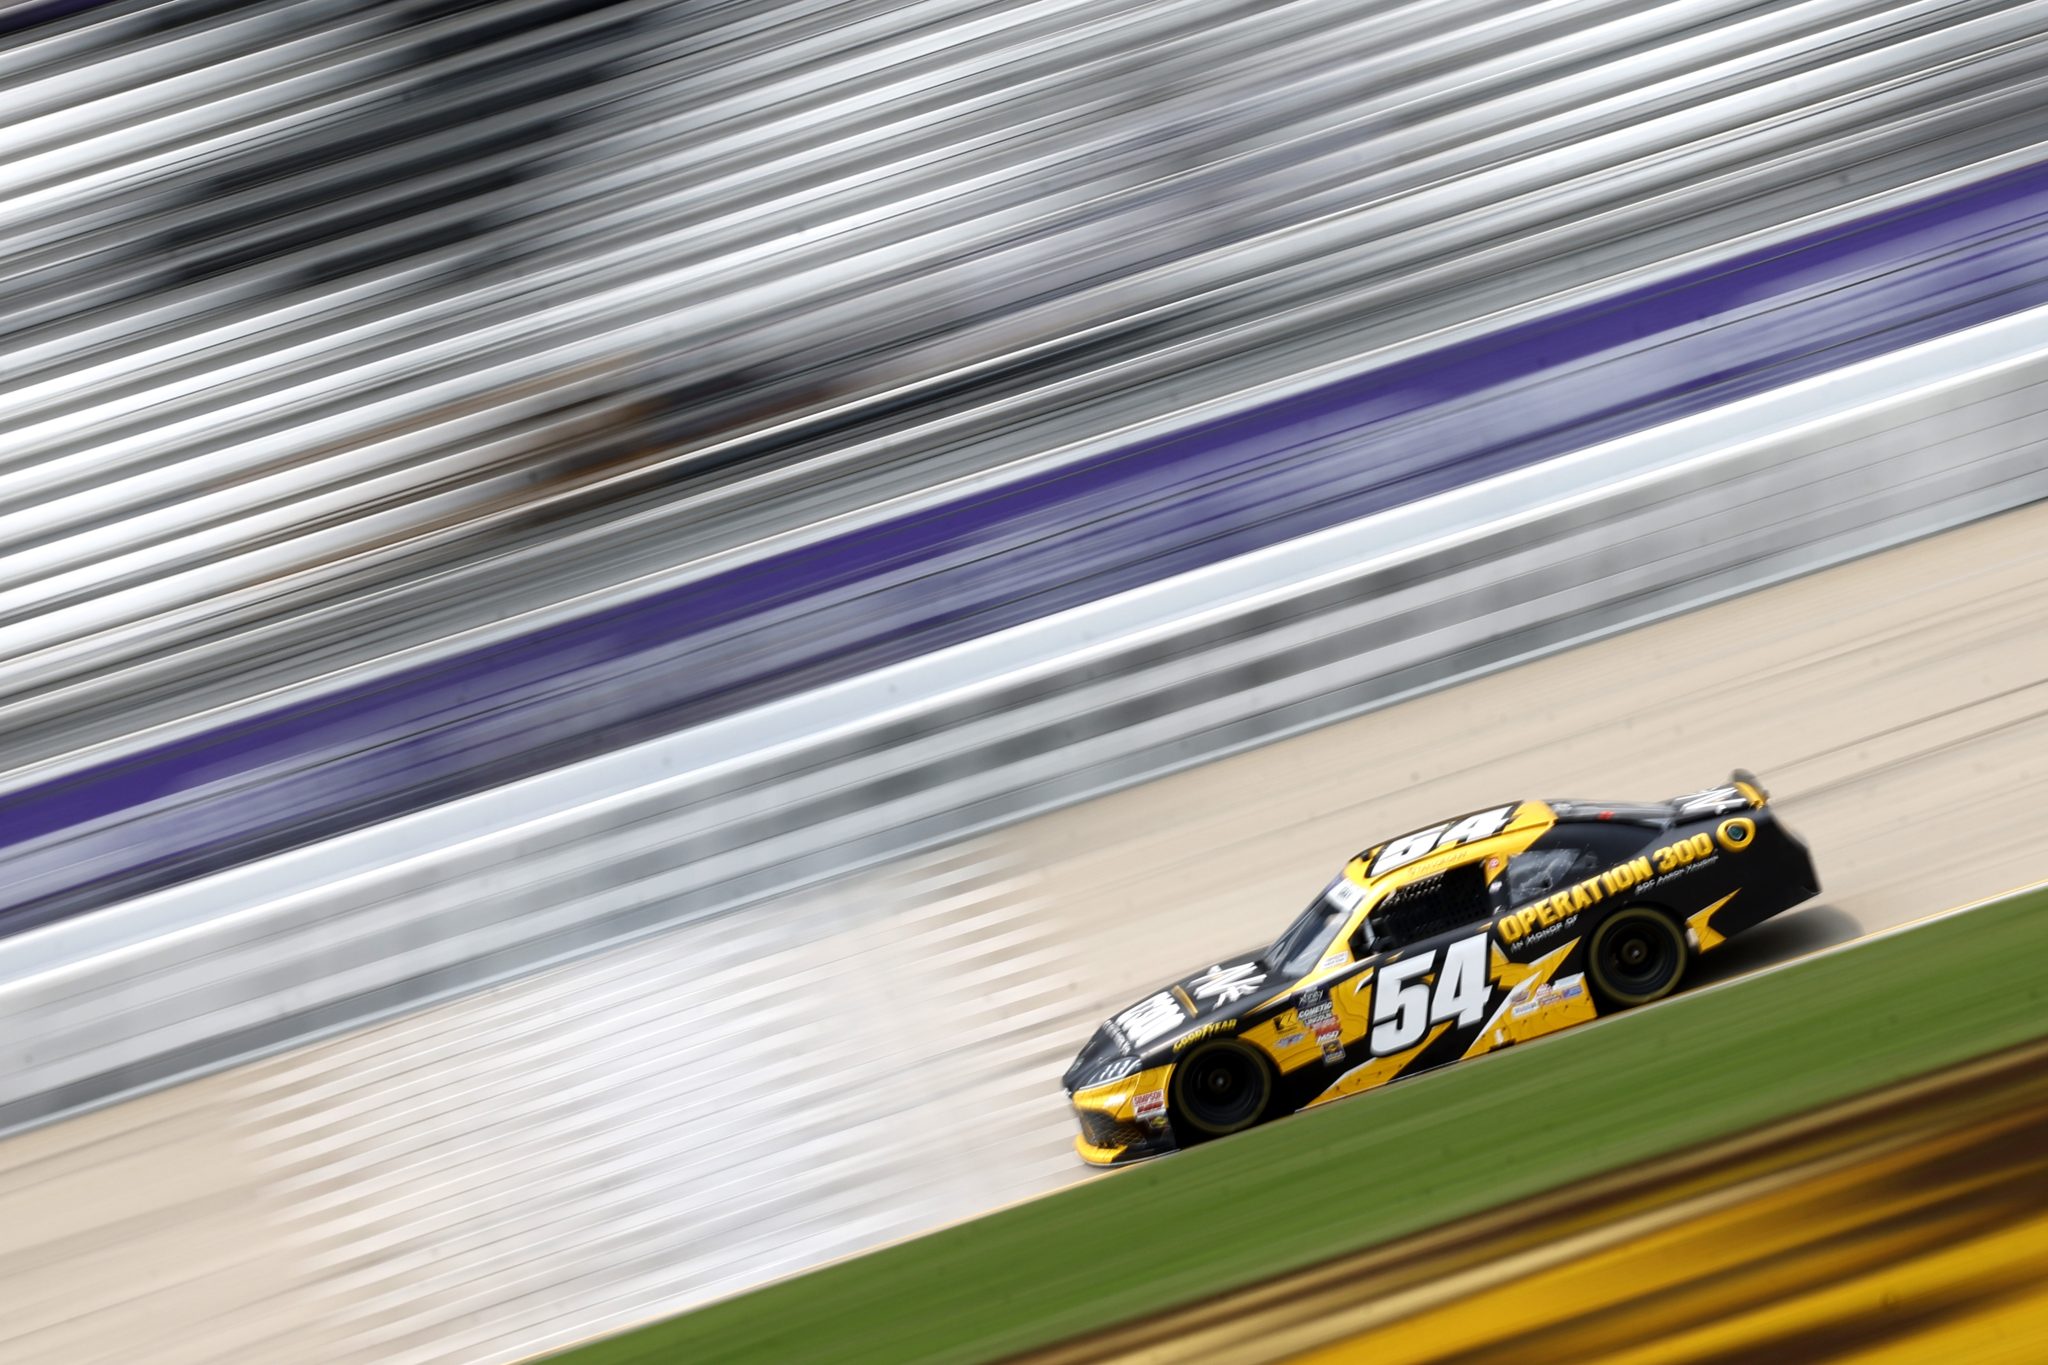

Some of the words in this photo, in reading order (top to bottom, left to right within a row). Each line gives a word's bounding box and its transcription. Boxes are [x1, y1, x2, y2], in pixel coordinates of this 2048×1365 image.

[1370, 804, 1514, 877] 54
[1497, 856, 1654, 944] OPERATION
[1652, 832, 1716, 875] 300
[1526, 921, 1563, 945] HONOR
[1564, 913, 1579, 928] OF
[1370, 932, 1493, 1056] 54
[1173, 1018, 1238, 1053] GOODYEAR
